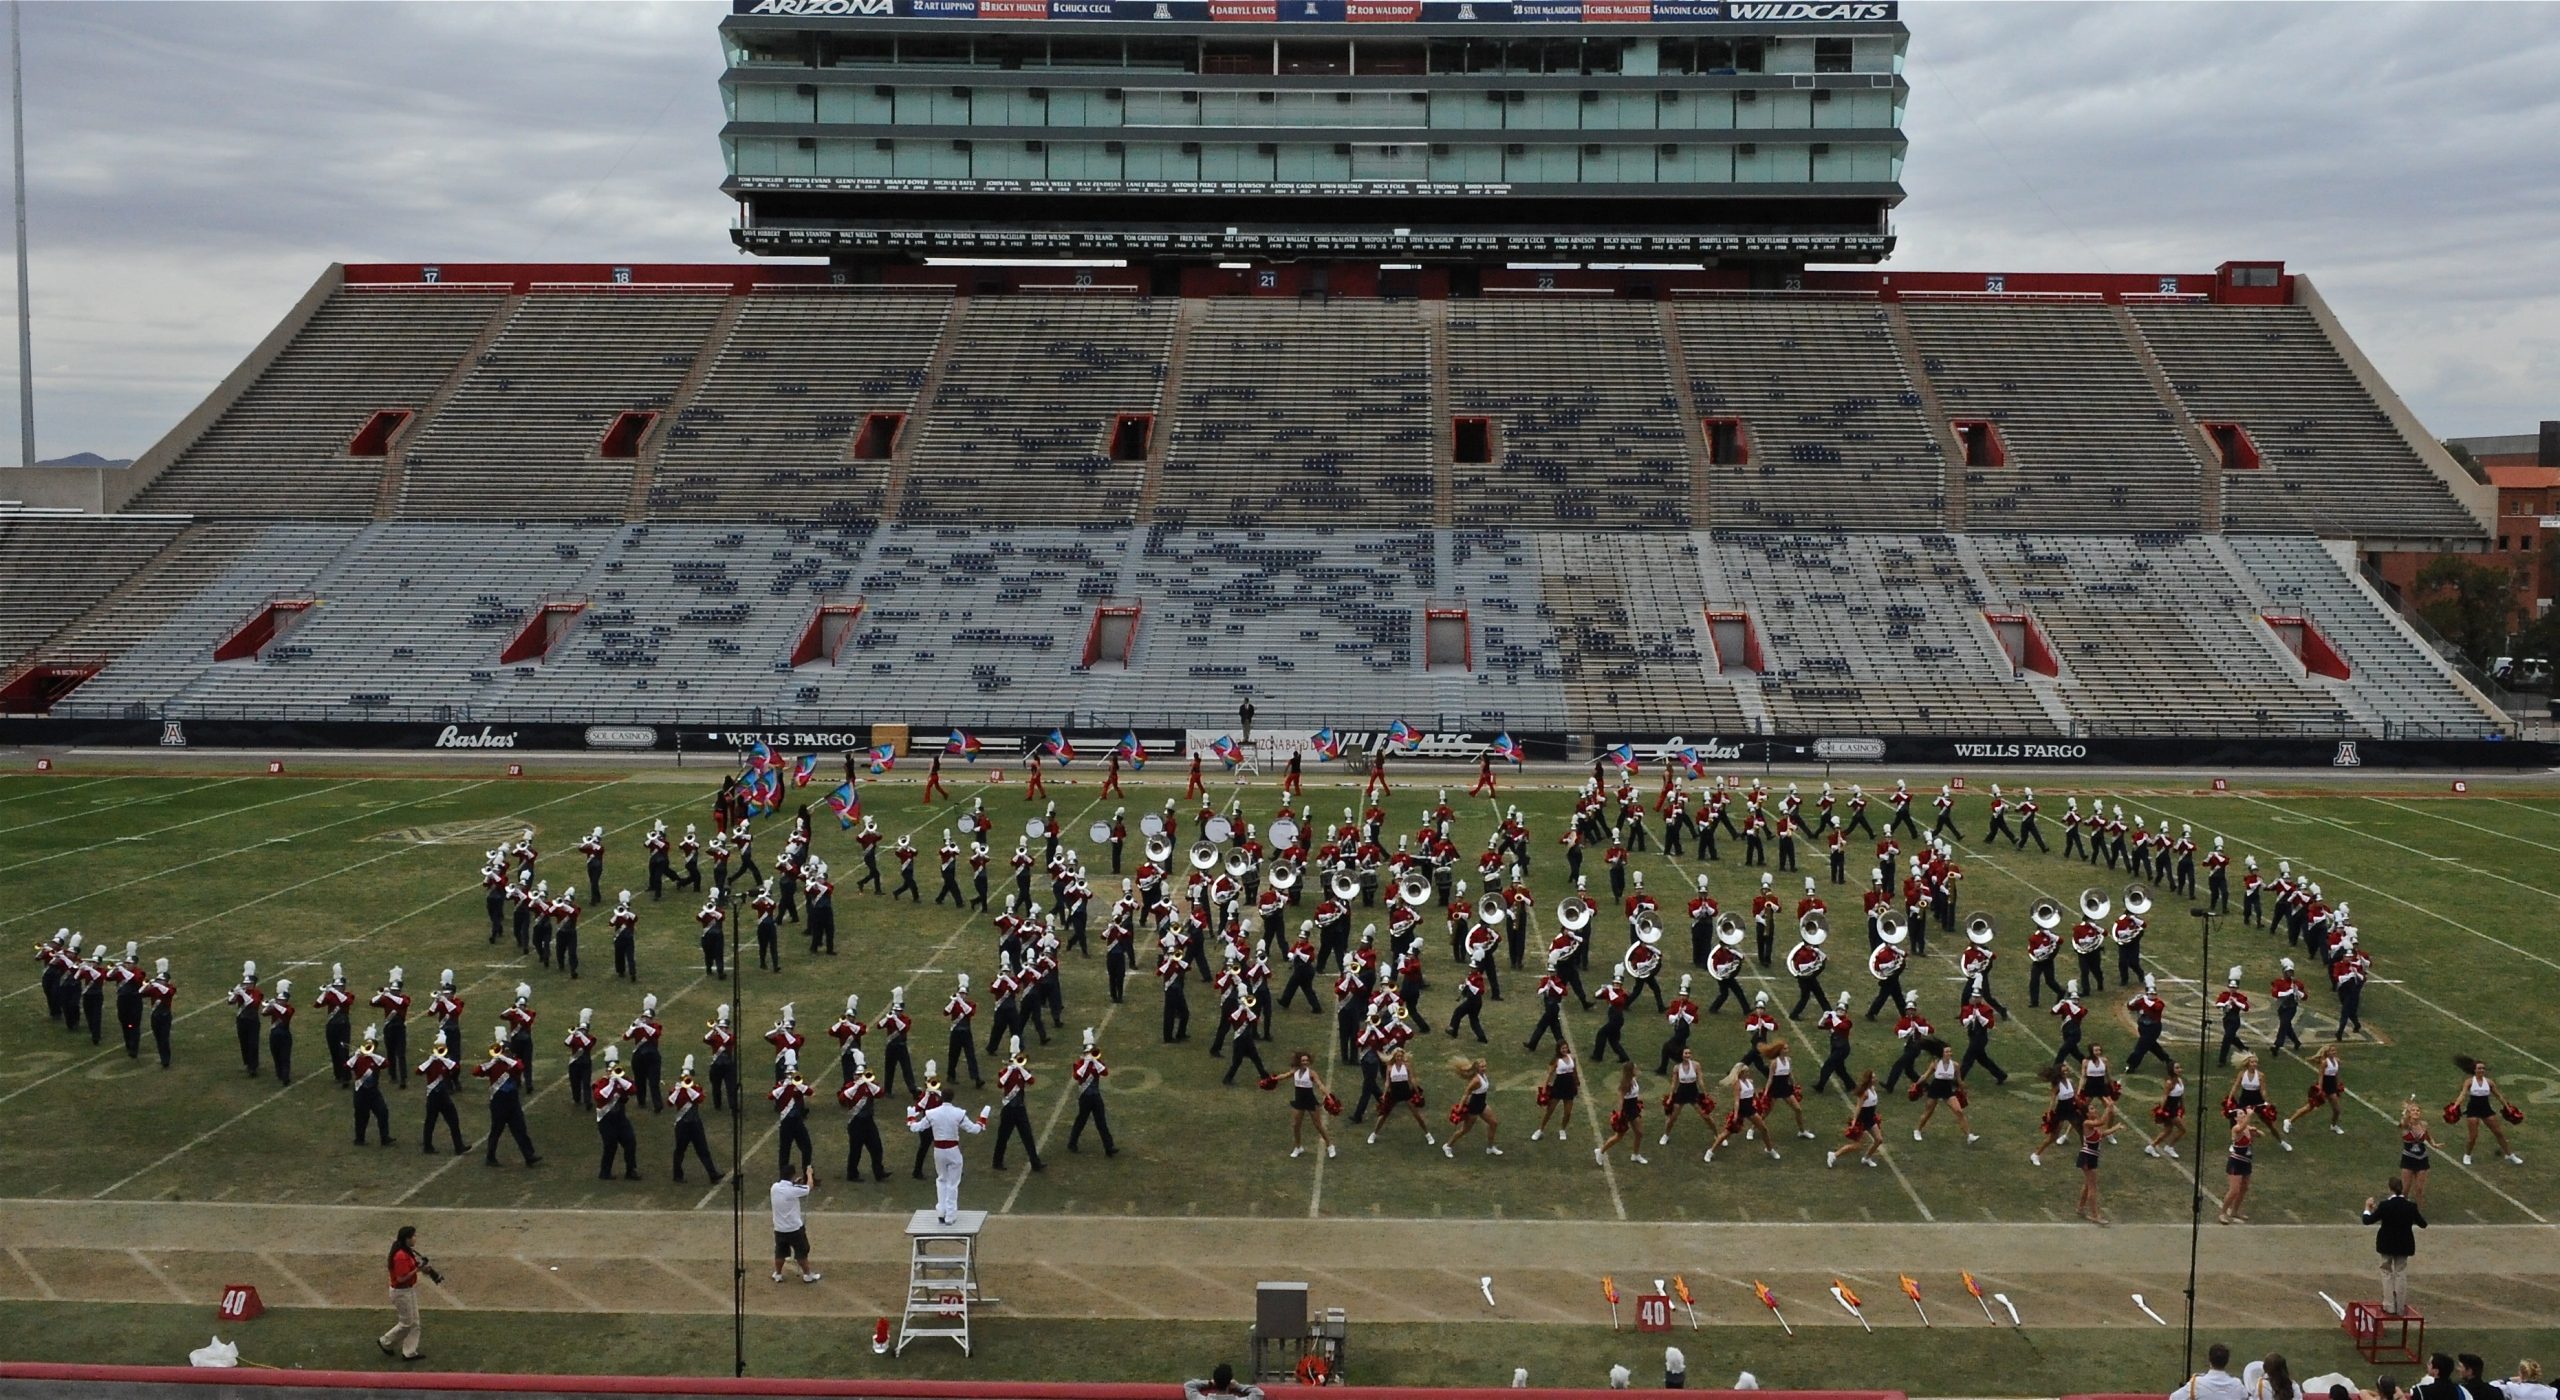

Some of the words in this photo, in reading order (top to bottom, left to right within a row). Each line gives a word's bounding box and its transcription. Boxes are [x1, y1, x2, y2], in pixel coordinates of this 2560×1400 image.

[749, 0, 894, 15] ARIZONA
[914, 2, 923, 10] 22
[924, 2, 939, 10] ART
[940, 2, 975, 10] LUPPINO
[981, 3, 990, 11] 89
[991, 3, 1012, 11] RICKY
[1013, 3, 1046, 11] HUNLEY
[1054, 4, 1059, 12] 6
[1061, 4, 1086, 12] CHUCK
[1087, 4, 1111, 12] CECIL
[1210, 6, 1215, 15] 4
[1216, 6, 1251, 15] DARRYLL
[1253, 6, 1276, 15] LEWIS
[1347, 6, 1357, 14] 92
[1358, 6, 1373, 14] ROB
[1374, 6, 1414, 14] WALDROP
[1514, 6, 1523, 14] 28
[1524, 6, 1541, 14] STEVE
[1542, 6, 1582, 14] McLAUGHLIN
[1583, 6, 1590, 14] 11
[1591, 6, 1612, 14] CHRIS
[1613, 6, 1651, 14] McALISTER
[1653, 6, 1658, 15] 5
[1659, 6, 1691, 15] ANTOINE
[1692, 6, 1719, 15] CASON
[1730, 4, 1888, 20] WILDCATS
[424, 273, 438, 283] 17
[615, 273, 629, 283] 18
[832, 274, 845, 284] 19
[1075, 275, 1091, 286] 20
[1261, 276, 1274, 286] 21
[1538, 278, 1554, 288] 22
[1786, 280, 1800, 290] 23
[1988, 282, 2002, 293] 24
[2160, 283, 2176, 294] 25
[435, 725, 518, 748] Bashas'
[592, 732, 607, 740] SOL
[611, 732, 650, 740] CASINOS
[725, 733, 789, 746] WELLS
[795, 733, 856, 746] FARGO
[1840, 744, 1879, 752] CASINOS
[1955, 744, 2020, 757] WELLS
[2023, 744, 2086, 758] FARGO
[38, 760, 48, 769] G
[270, 763, 280, 772] 10
[1729, 777, 1739, 785] 30
[1954, 779, 1963, 787] 20
[2216, 780, 2225, 789] 10
[222, 1290, 246, 1315] 40
[940, 1296, 959, 1316] 50
[1642, 1301, 1665, 1326] 40
